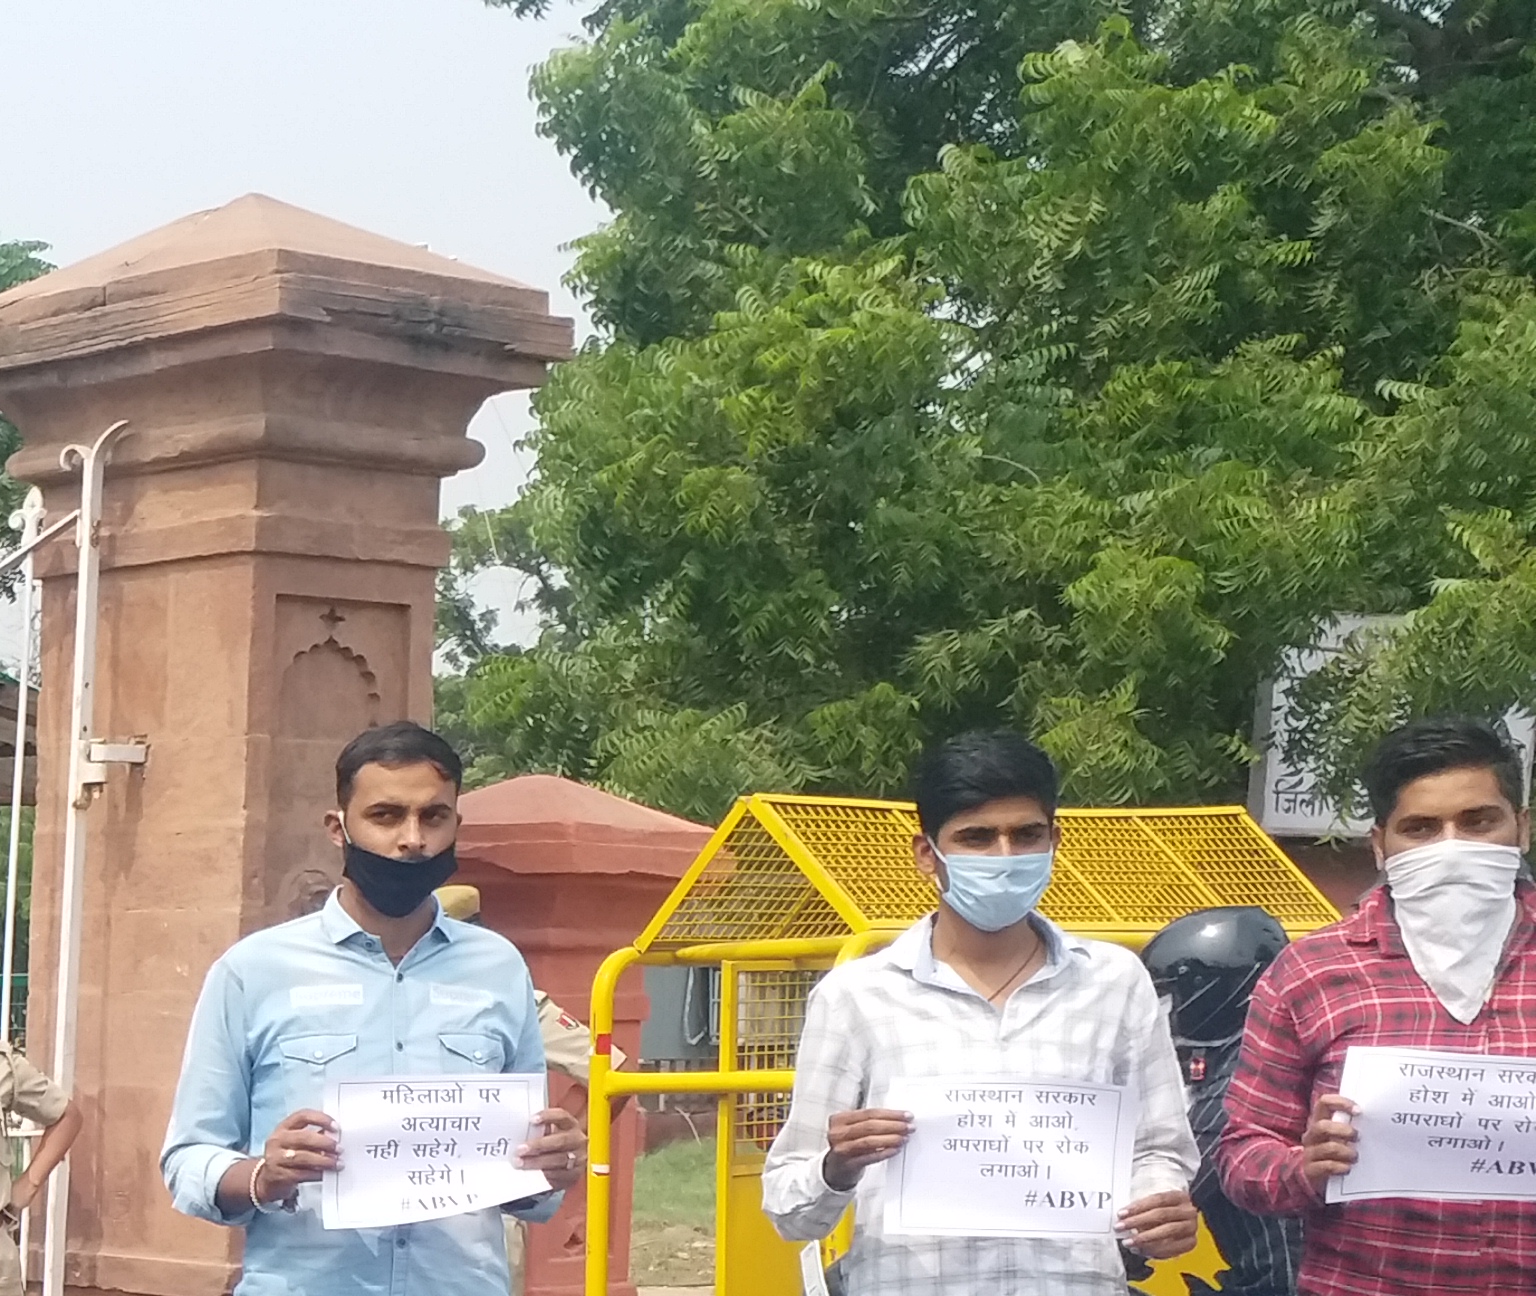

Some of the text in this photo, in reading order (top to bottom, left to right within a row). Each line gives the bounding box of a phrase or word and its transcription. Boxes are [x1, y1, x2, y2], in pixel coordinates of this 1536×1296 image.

[1400, 1063, 1484, 1082] राजस्थान
[381, 1083, 501, 1104] महिलाओं पर
[945, 1090, 1097, 1106] राजस्थान सरकार
[1409, 1085, 1449, 1104] होश
[1462, 1088, 1477, 1106] में
[402, 1116, 481, 1131] अत्याचार
[958, 1110, 992, 1129] होश
[1005, 1110, 1017, 1128] में
[1478, 1118, 1502, 1131] पर
[366, 1139, 400, 1158] नहीं
[476, 1138, 511, 1156] नहीं
[1023, 1140, 1043, 1154] पर
[1056, 1136, 1089, 1154] रोक
[1025, 1191, 1112, 1209] #ABVP
